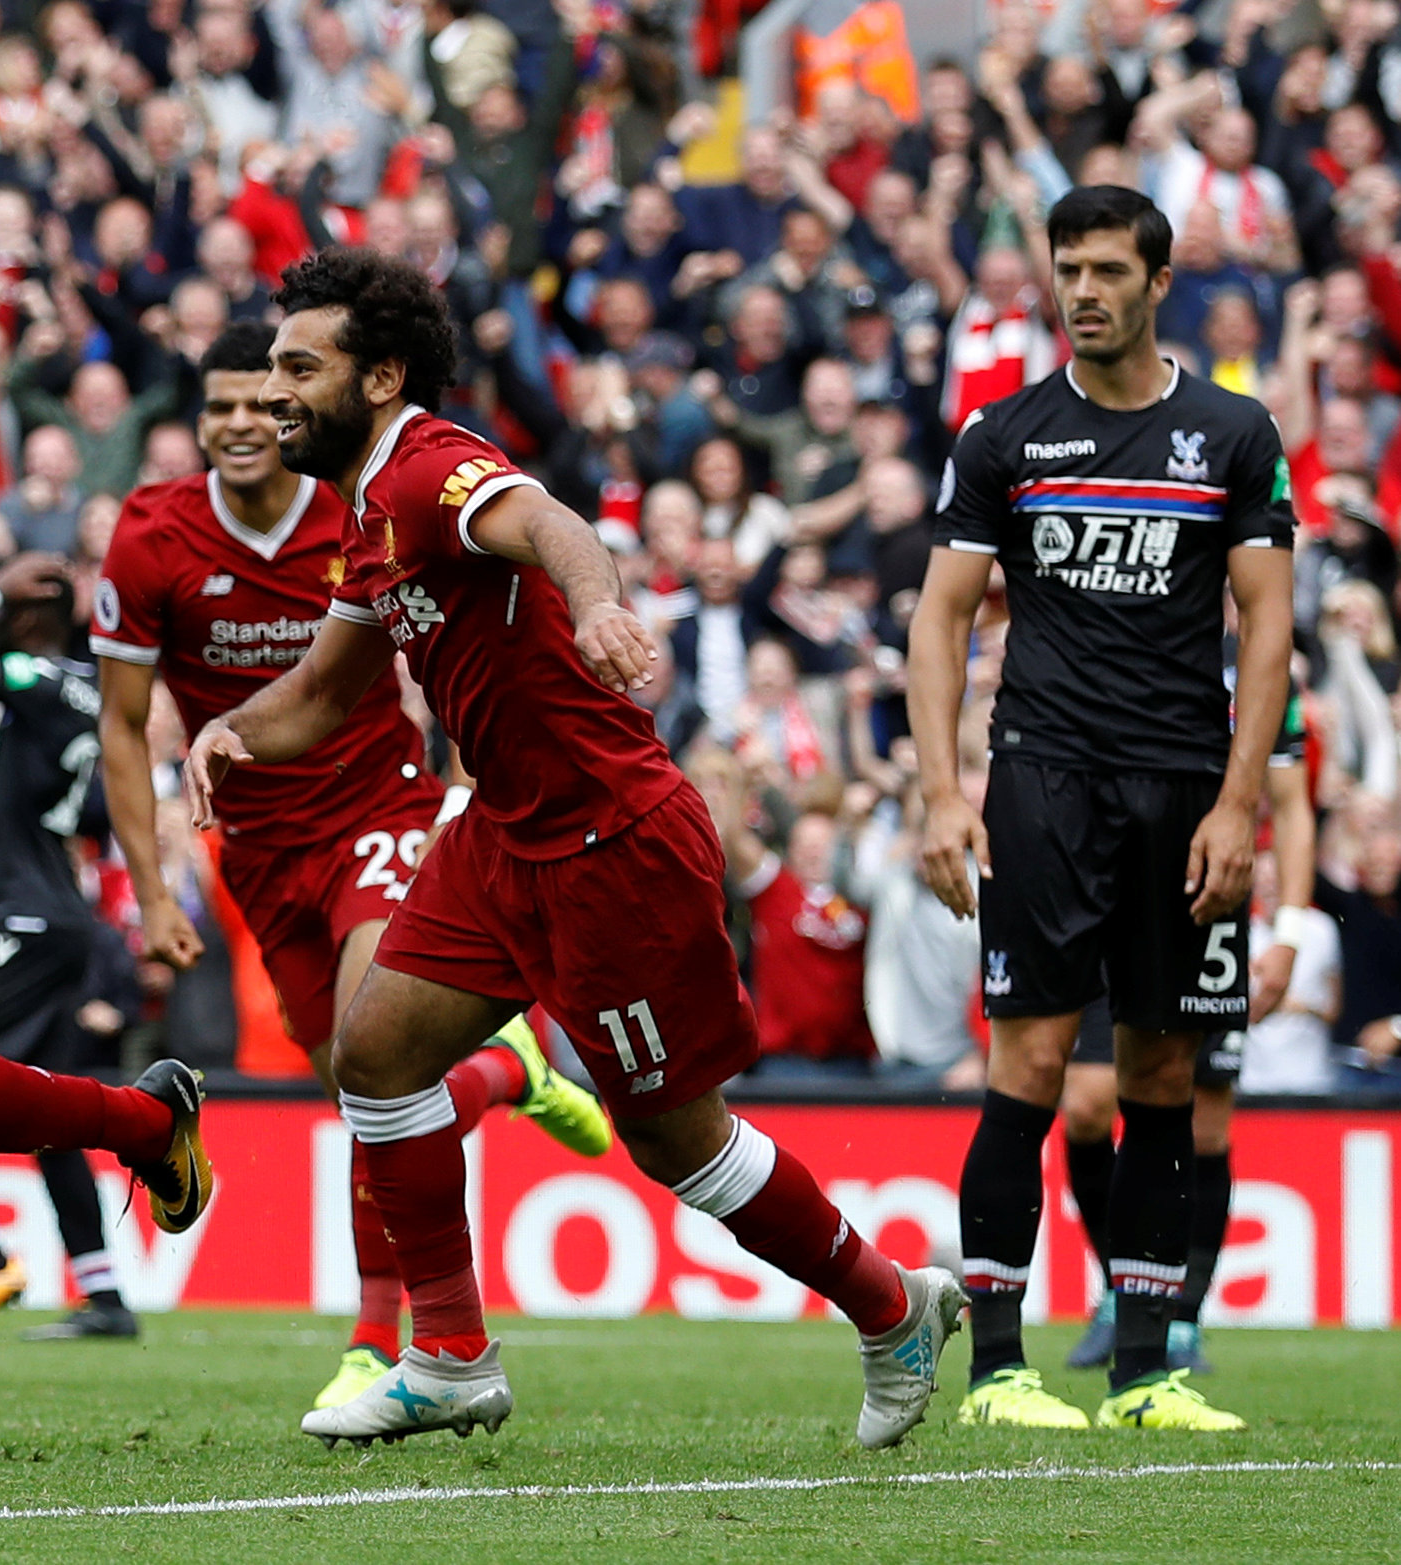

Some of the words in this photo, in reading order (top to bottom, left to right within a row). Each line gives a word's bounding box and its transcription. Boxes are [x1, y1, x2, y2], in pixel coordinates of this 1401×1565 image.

[1024, 439, 1096, 460] macron
[1075, 515, 1180, 568] 万博
[202, 644, 310, 667] Charter
[1198, 922, 1237, 993] 5
[1180, 996, 1246, 1014] macron
[599, 999, 667, 1073] 11
[310, 1118, 1392, 1329] ospal
